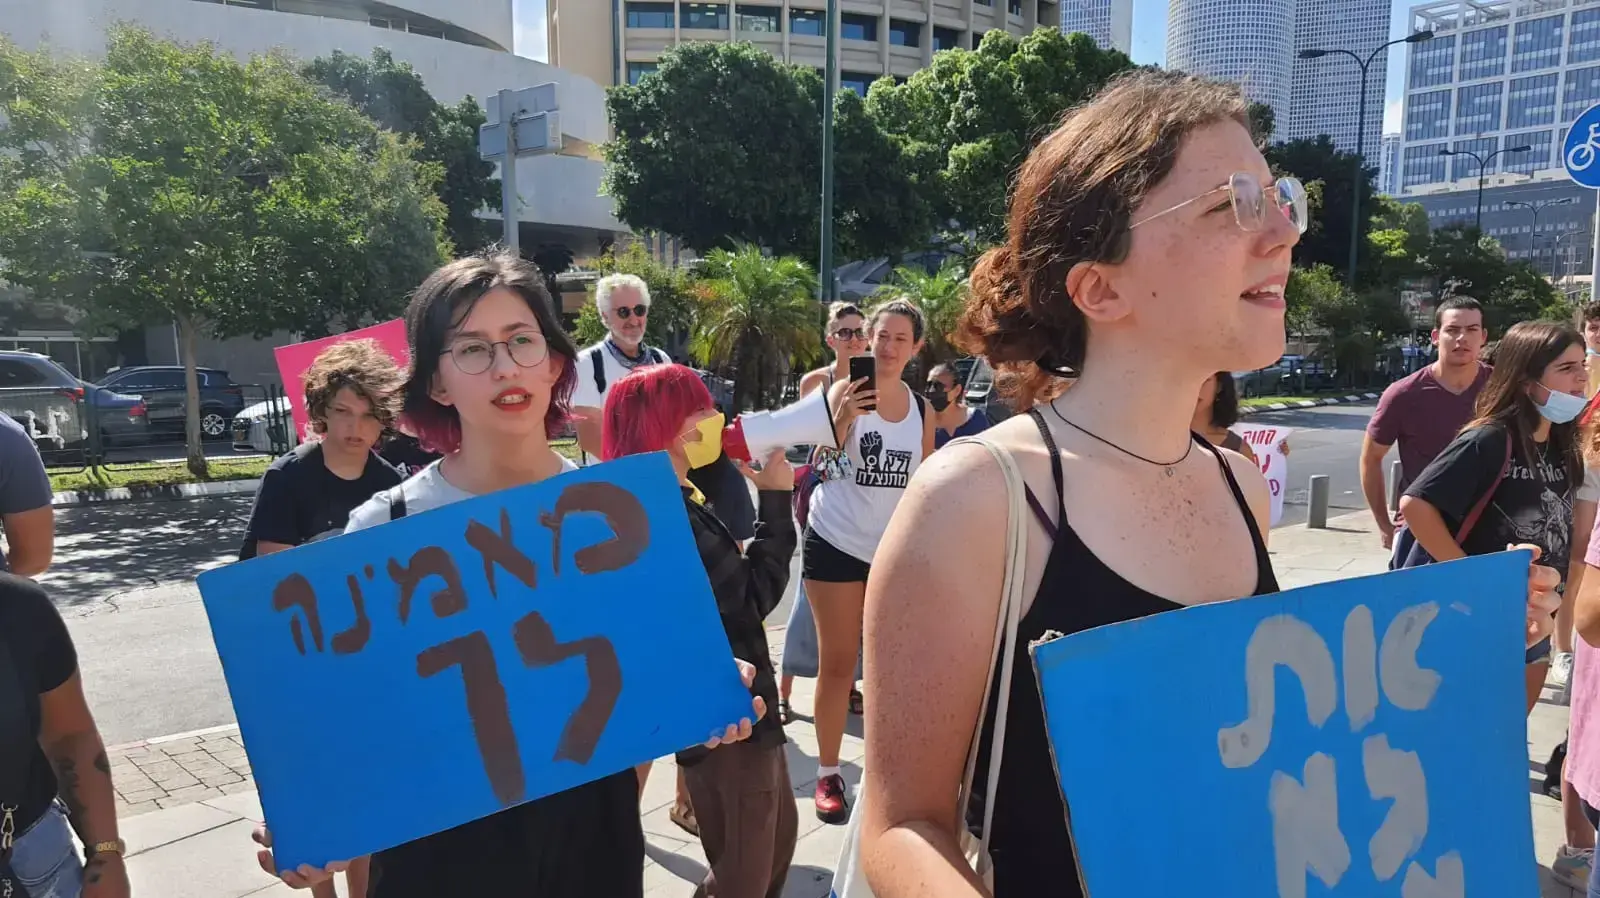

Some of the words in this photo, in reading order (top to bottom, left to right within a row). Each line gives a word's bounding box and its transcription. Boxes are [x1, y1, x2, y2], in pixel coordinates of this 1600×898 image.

[856, 470, 907, 487] מתנצלת
[272, 481, 651, 656] מאמינה
[416, 610, 623, 805] לך
[1217, 600, 1443, 768] את
[1268, 732, 1429, 898] לא
